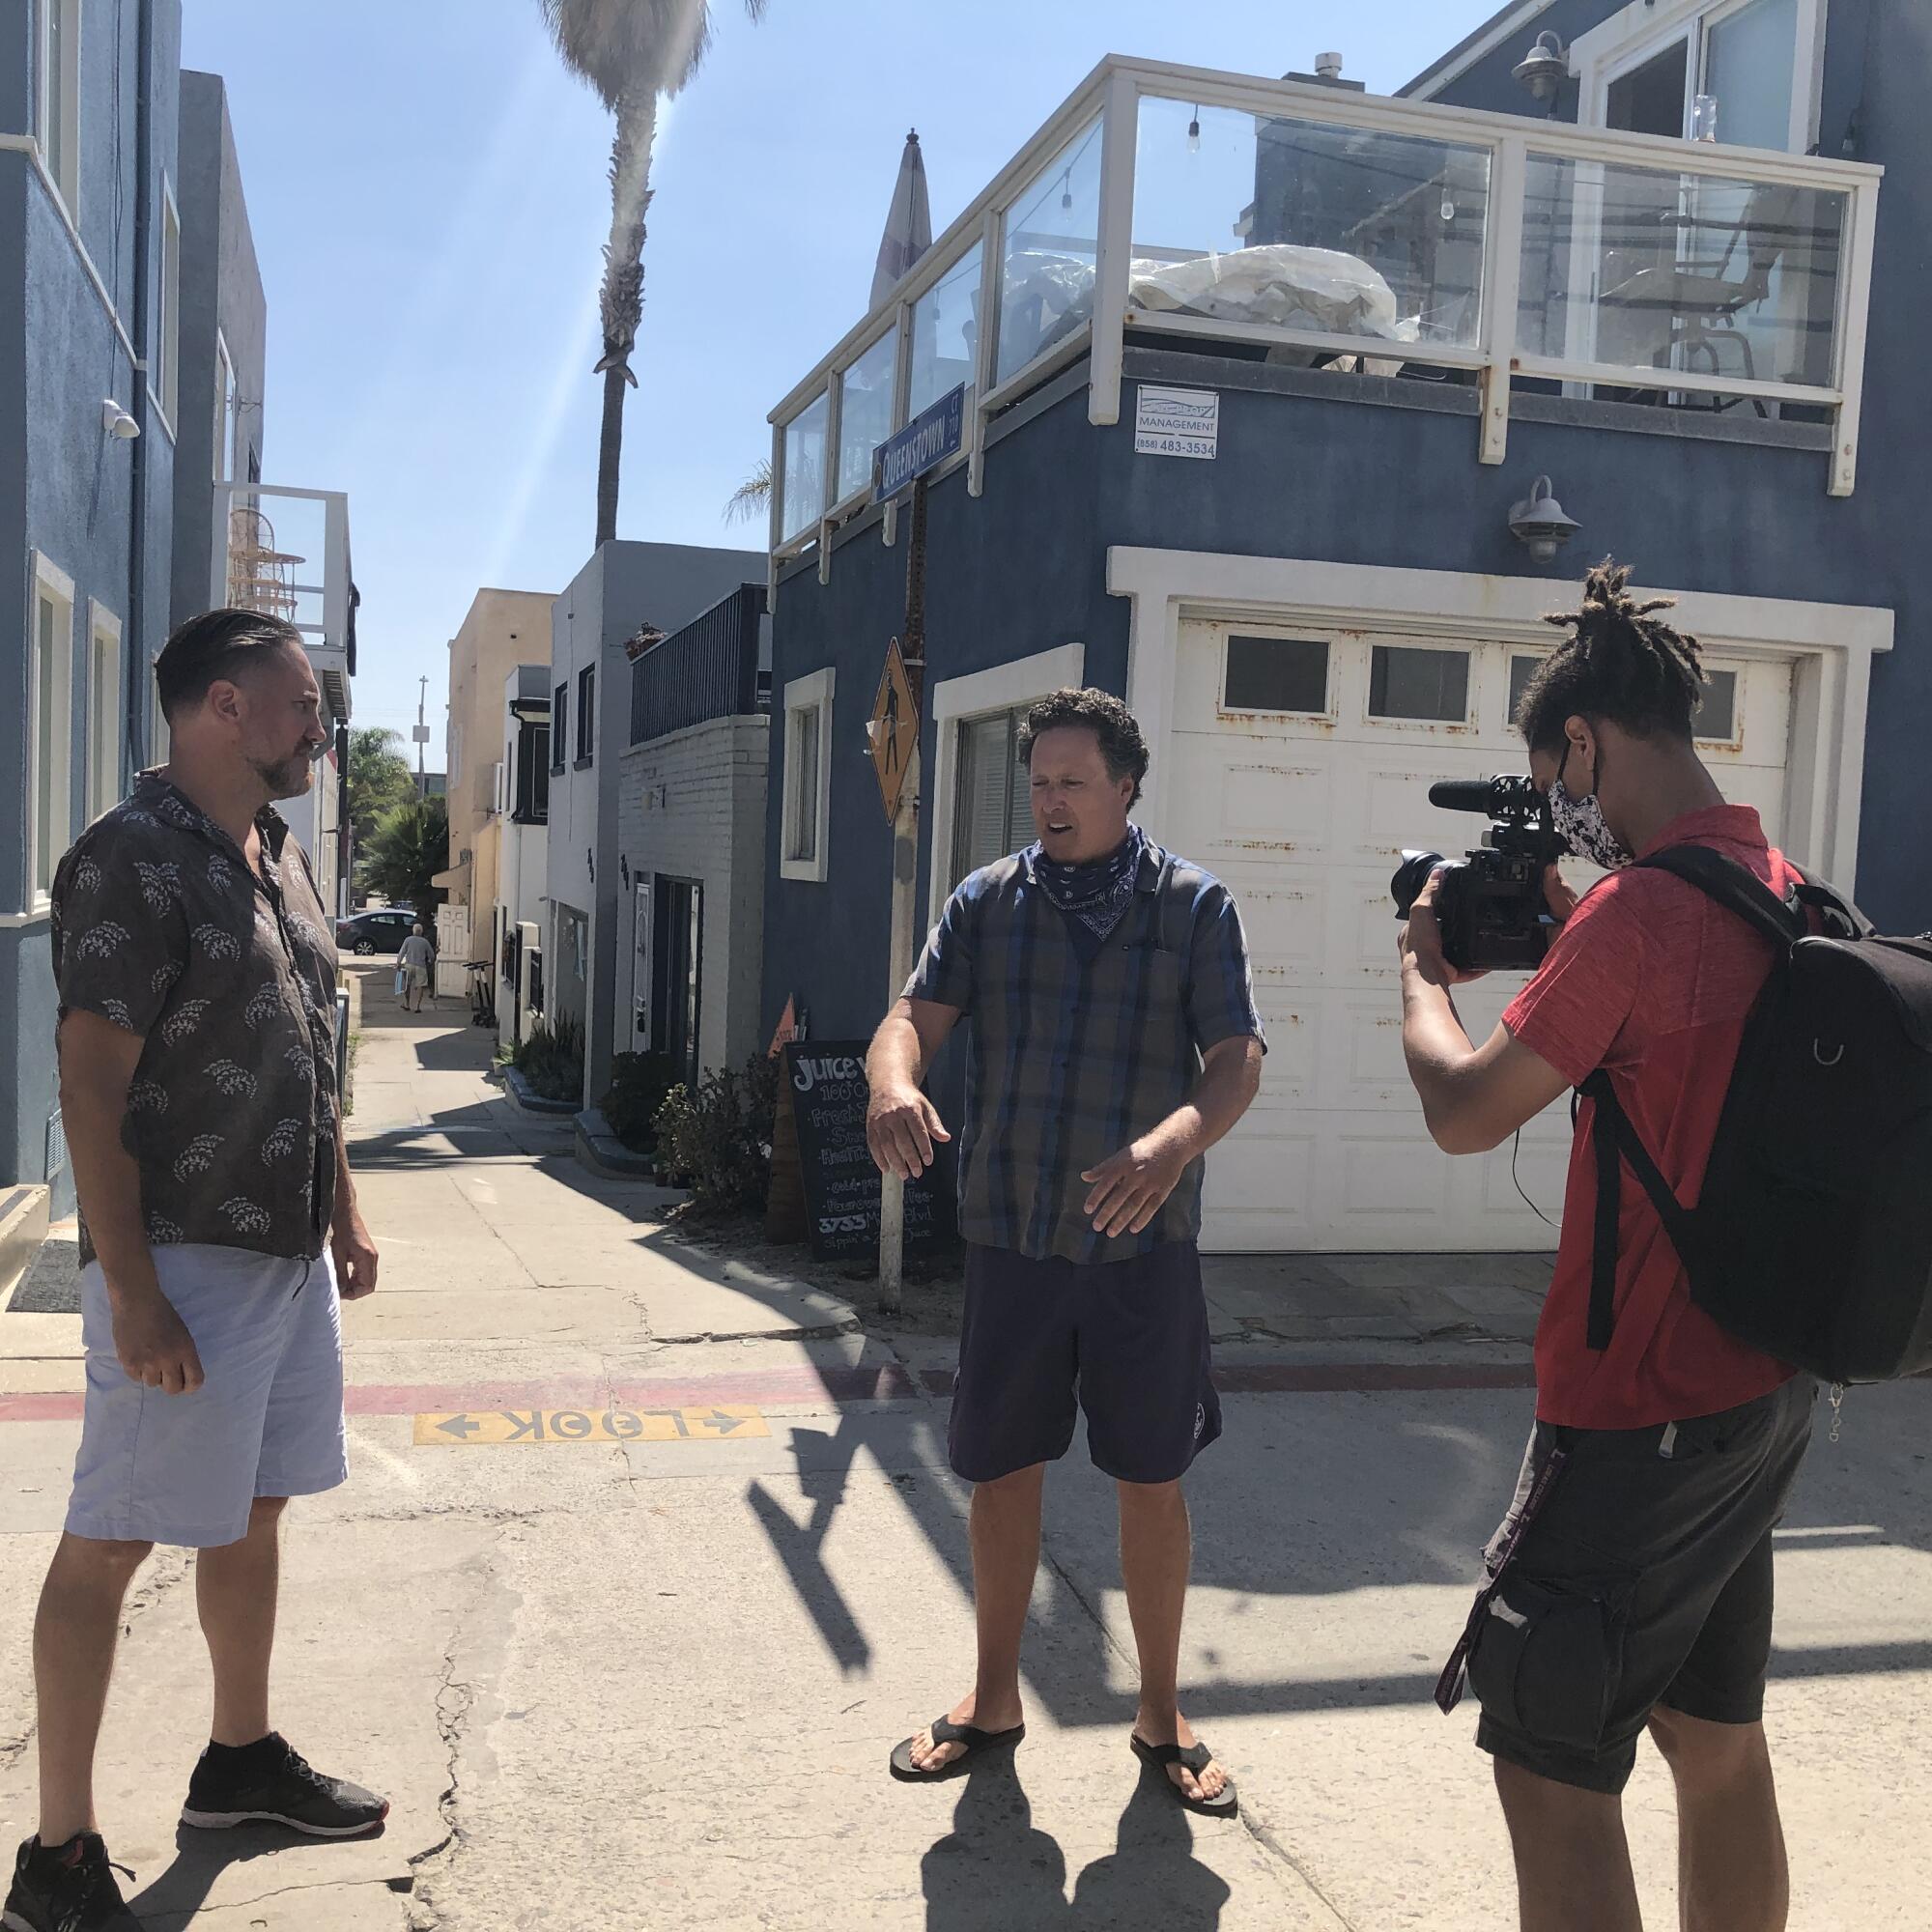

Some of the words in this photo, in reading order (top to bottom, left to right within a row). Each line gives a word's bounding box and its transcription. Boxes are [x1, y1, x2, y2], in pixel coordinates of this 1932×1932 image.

[1140, 416, 1215, 432] MANAGEMENT
[882, 412, 946, 489] QUEENSTOWN
[1137, 439, 1158, 449] (858)
[1160, 440, 1215, 456] 483-3534
[500, 1409, 690, 1440] LOOK
